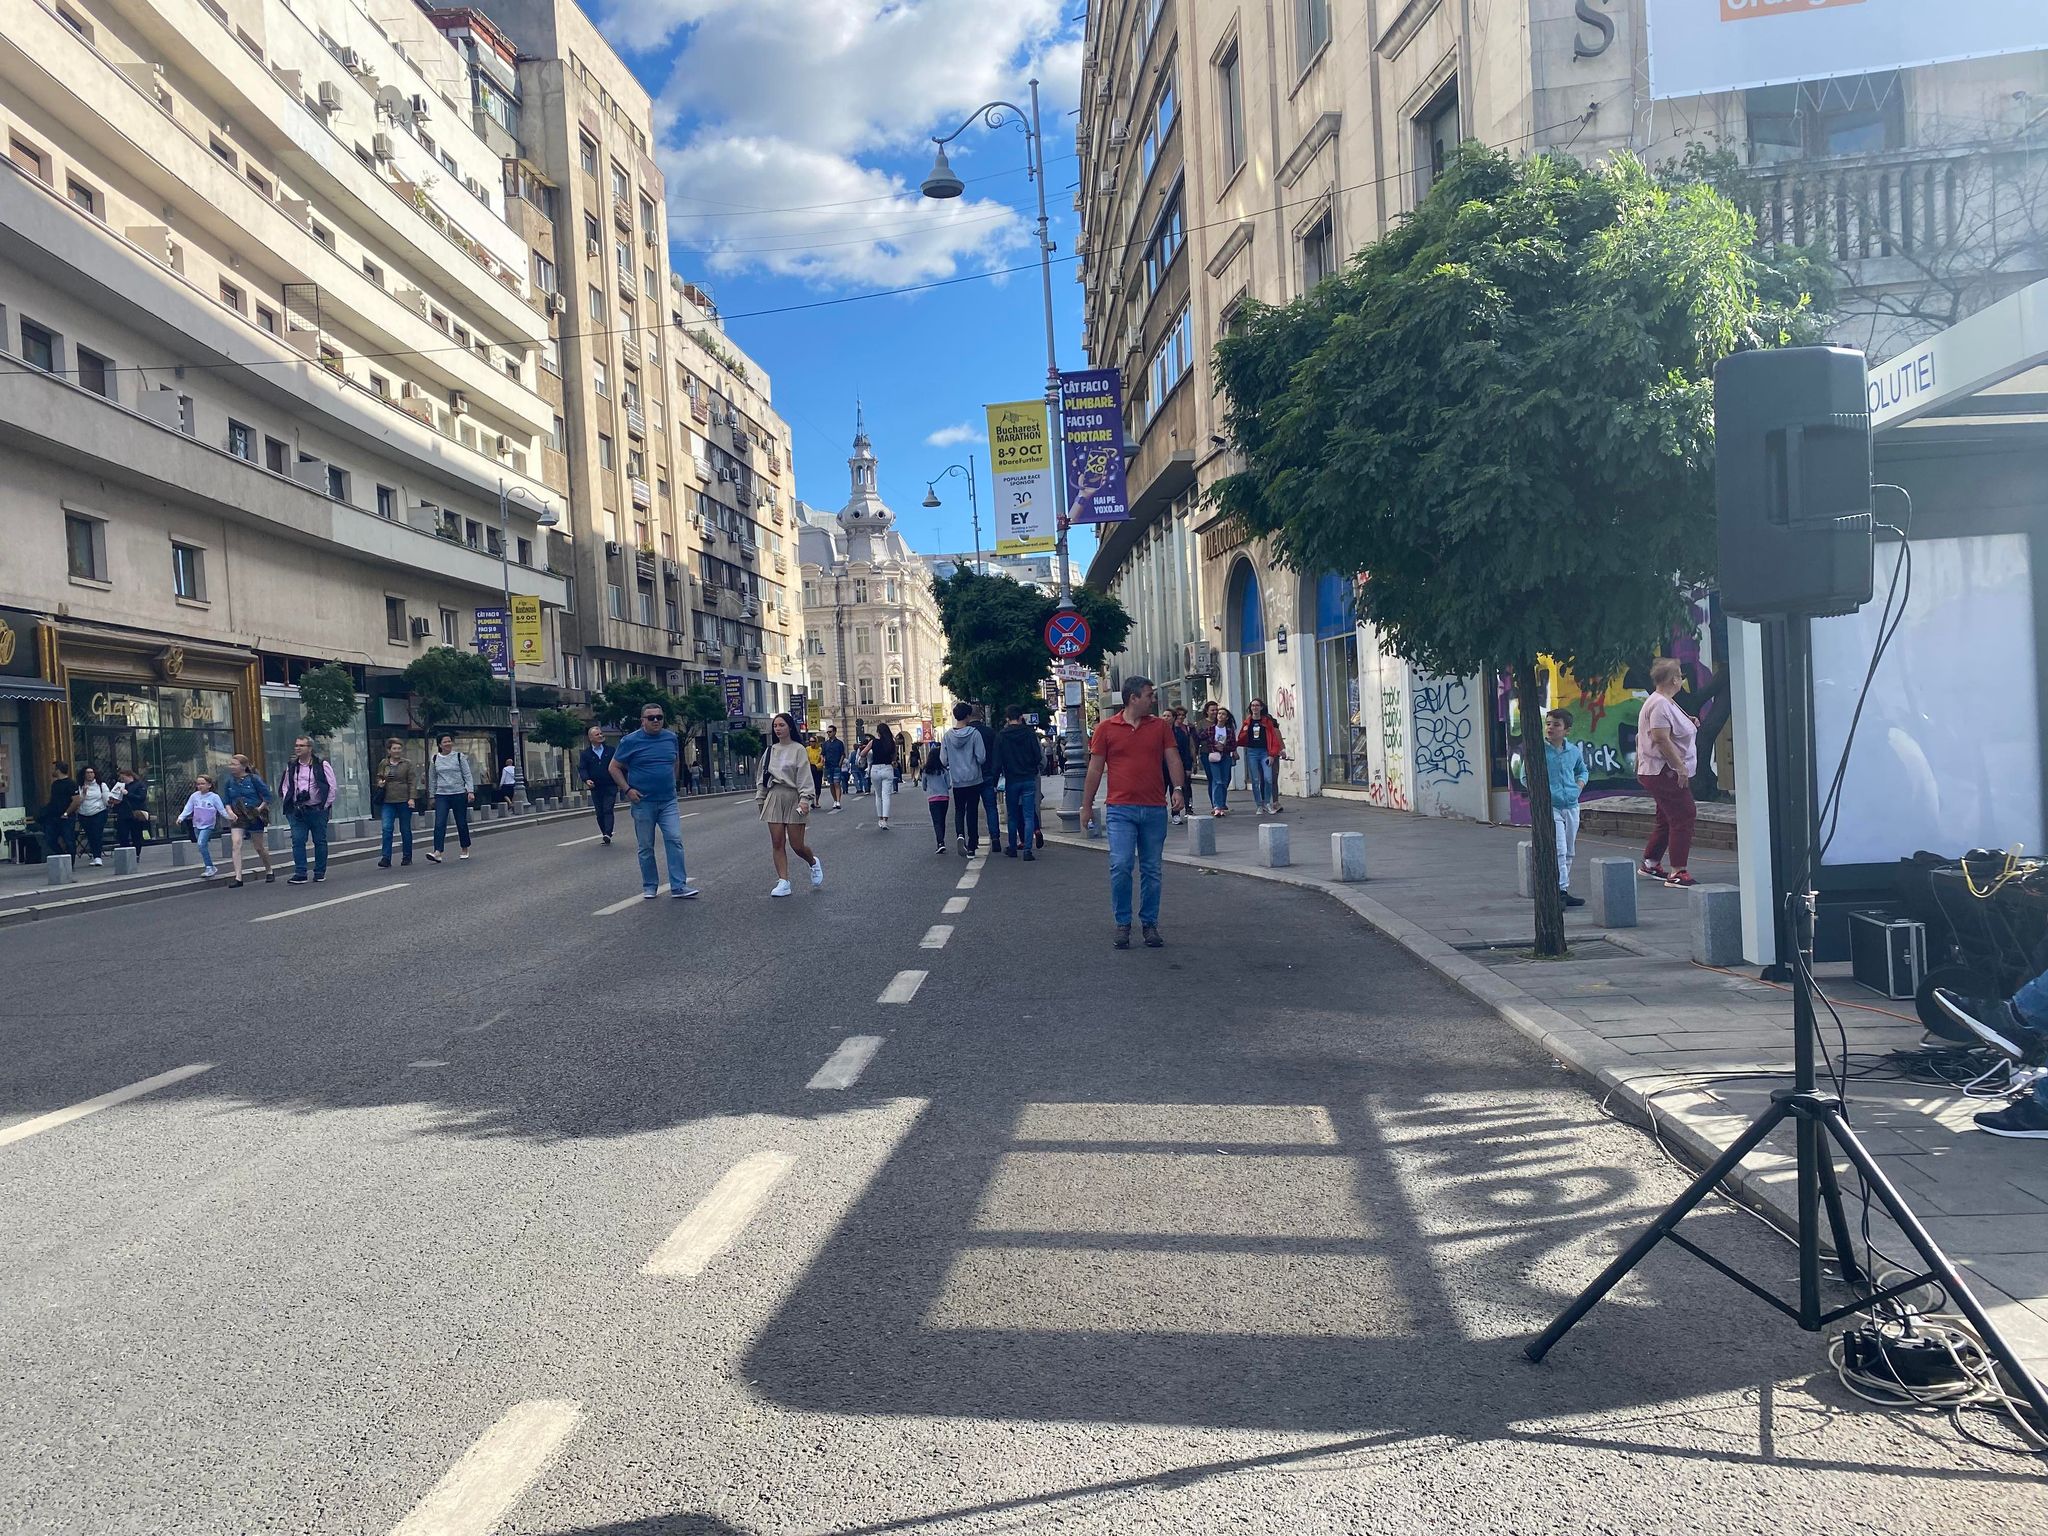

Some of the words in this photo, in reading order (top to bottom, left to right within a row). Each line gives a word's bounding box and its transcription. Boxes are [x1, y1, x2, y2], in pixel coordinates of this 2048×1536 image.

[1064, 381, 1080, 394] CÂT
[1081, 380, 1100, 393] FACI
[1102, 380, 1109, 391] O
[1066, 415, 1085, 427] FACI
[1096, 414, 1103, 425] O
[996, 422, 1040, 435] Bucharest
[997, 431, 1041, 443] MARATHON
[1068, 429, 1113, 443] PORTARE
[998, 447, 1016, 458] 8-9
[1019, 445, 1043, 456] OCT
[1093, 496, 1106, 505] HAI
[1107, 496, 1116, 504] PE
[1094, 505, 1124, 514] YOXO.RO
[1011, 512, 1029, 525] EY
